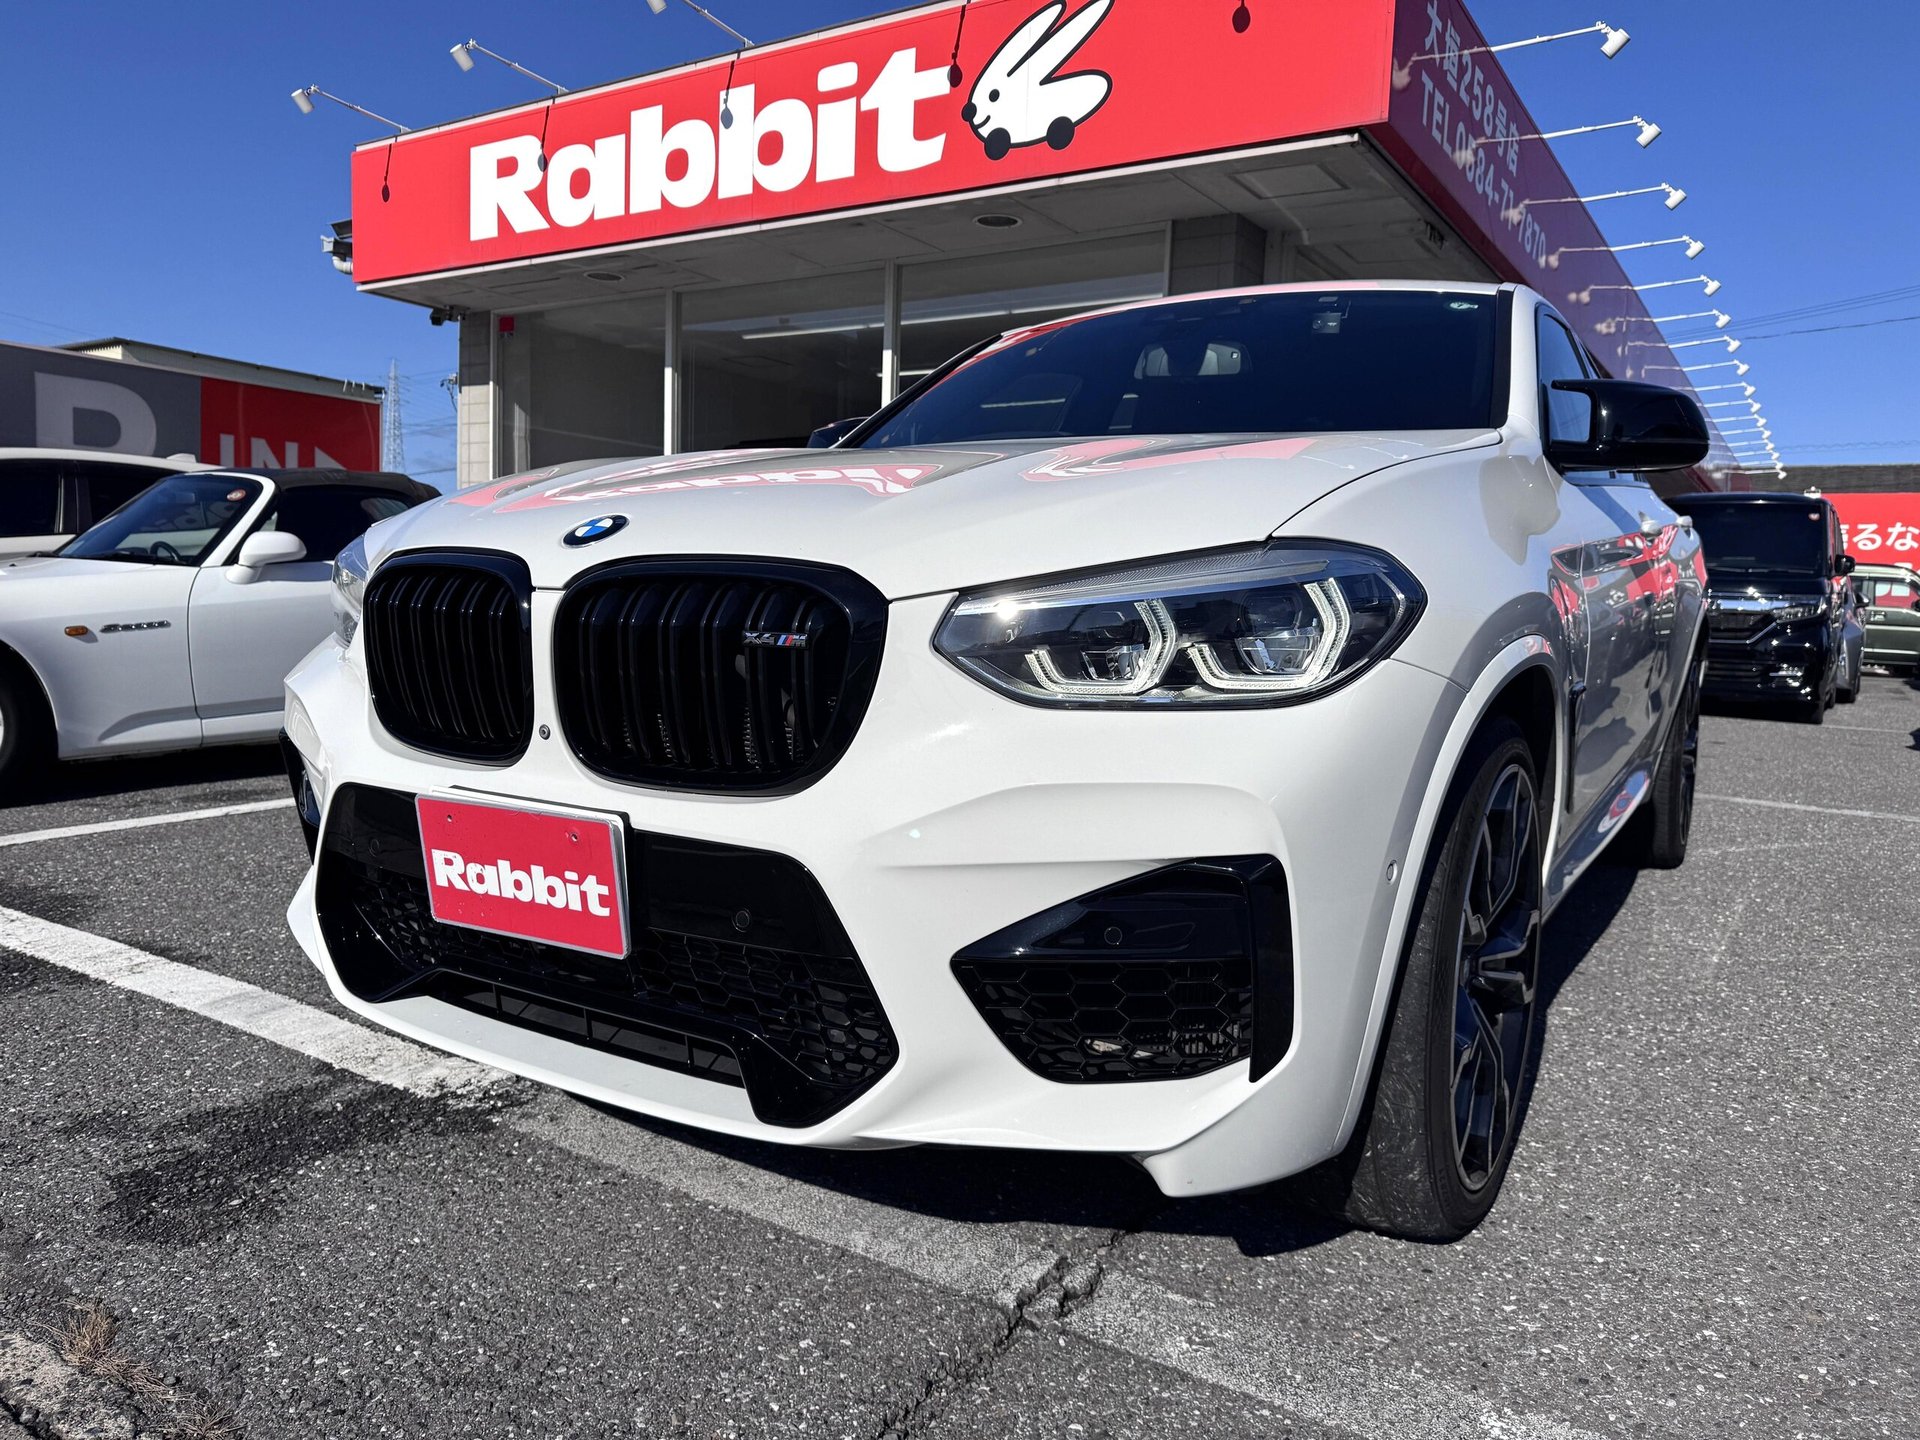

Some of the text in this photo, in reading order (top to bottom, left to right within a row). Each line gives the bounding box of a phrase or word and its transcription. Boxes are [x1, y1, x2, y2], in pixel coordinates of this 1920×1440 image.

[469, 47, 951, 241] Rabbit
[1425, 0, 1519, 176] 大垣258号店
[431, 848, 611, 917] Rabbit
